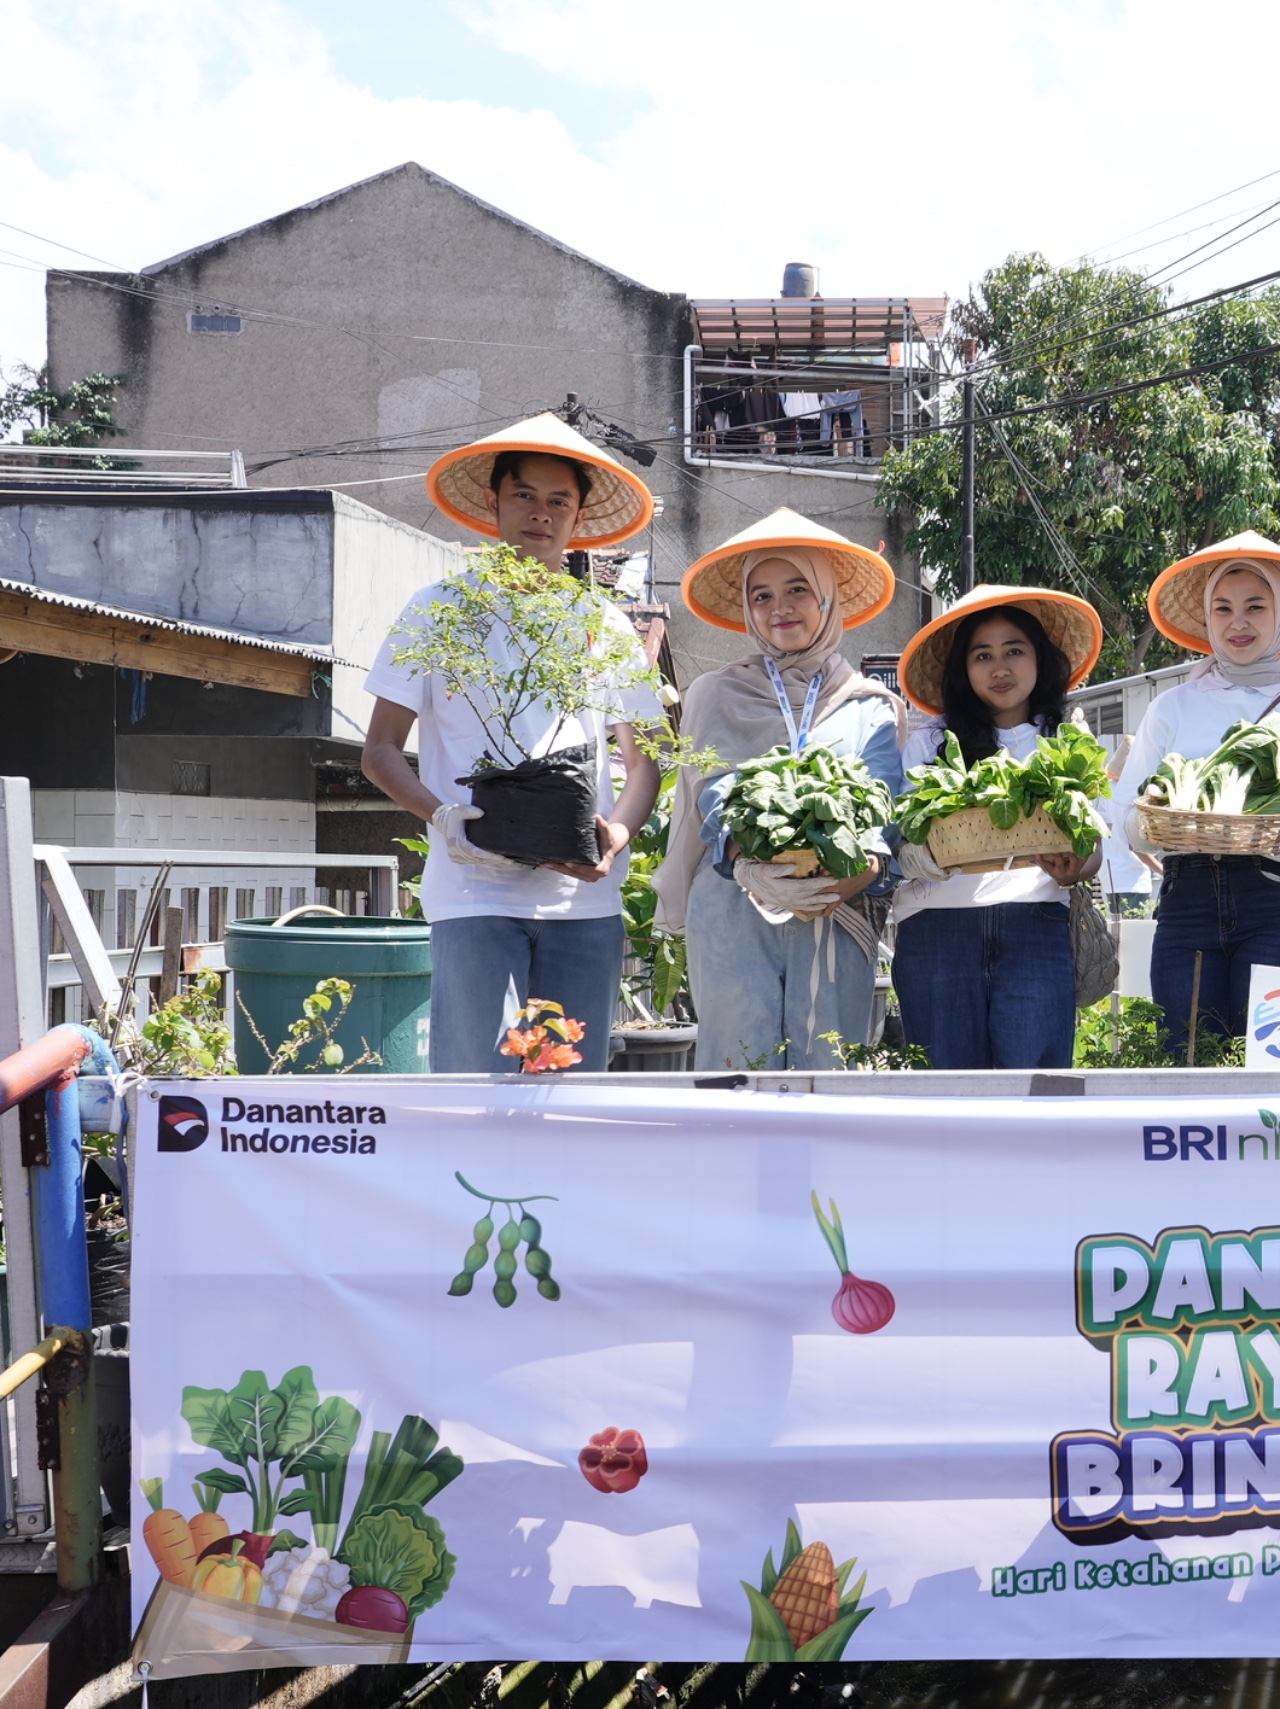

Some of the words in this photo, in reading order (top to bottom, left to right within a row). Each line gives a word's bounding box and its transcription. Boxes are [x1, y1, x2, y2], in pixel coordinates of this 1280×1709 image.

[221, 1096, 387, 1125] Danantara
[220, 1126, 377, 1155] Indonesia
[992, 1562, 1066, 1597] Hari
[1075, 1552, 1253, 1590] Ketahanan
